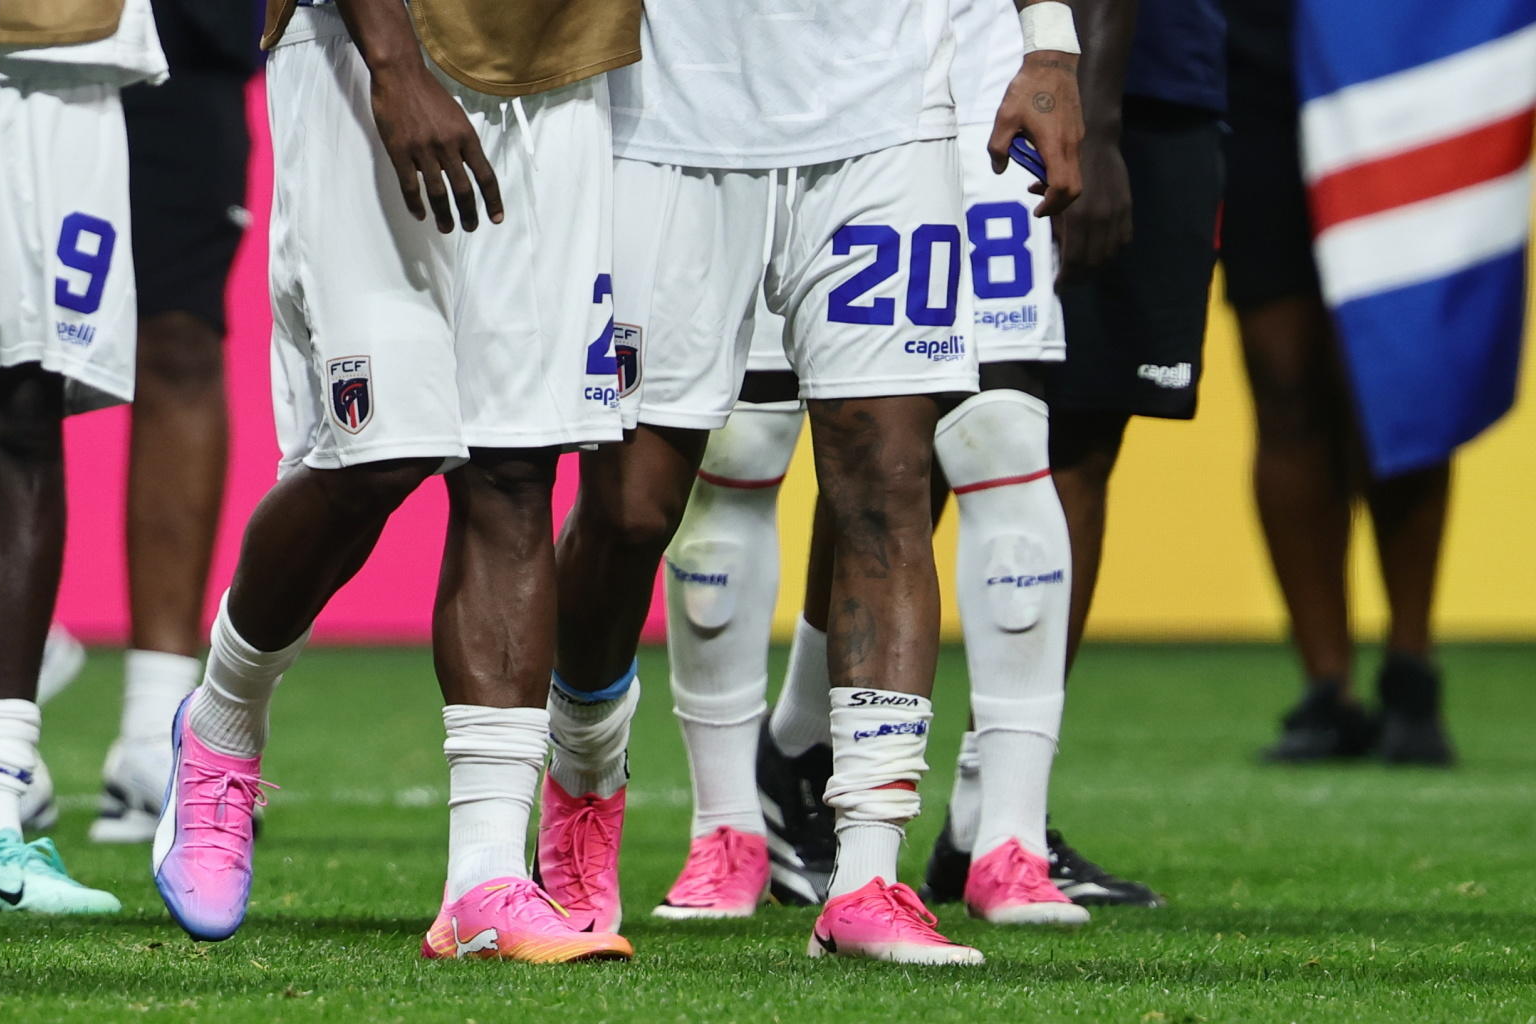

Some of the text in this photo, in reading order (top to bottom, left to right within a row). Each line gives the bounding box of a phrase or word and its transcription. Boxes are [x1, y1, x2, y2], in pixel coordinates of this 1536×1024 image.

[966, 201, 1034, 300] 8
[55, 211, 116, 315] 9
[827, 224, 962, 326] 20
[56, 321, 97, 344] pelli
[613, 326, 638, 340] CF
[1001, 323, 1038, 332] SPORT
[904, 335, 966, 359] capelli
[330, 360, 367, 376] FCF
[1137, 362, 1192, 384] capelli
[848, 691, 919, 707] SENDA
